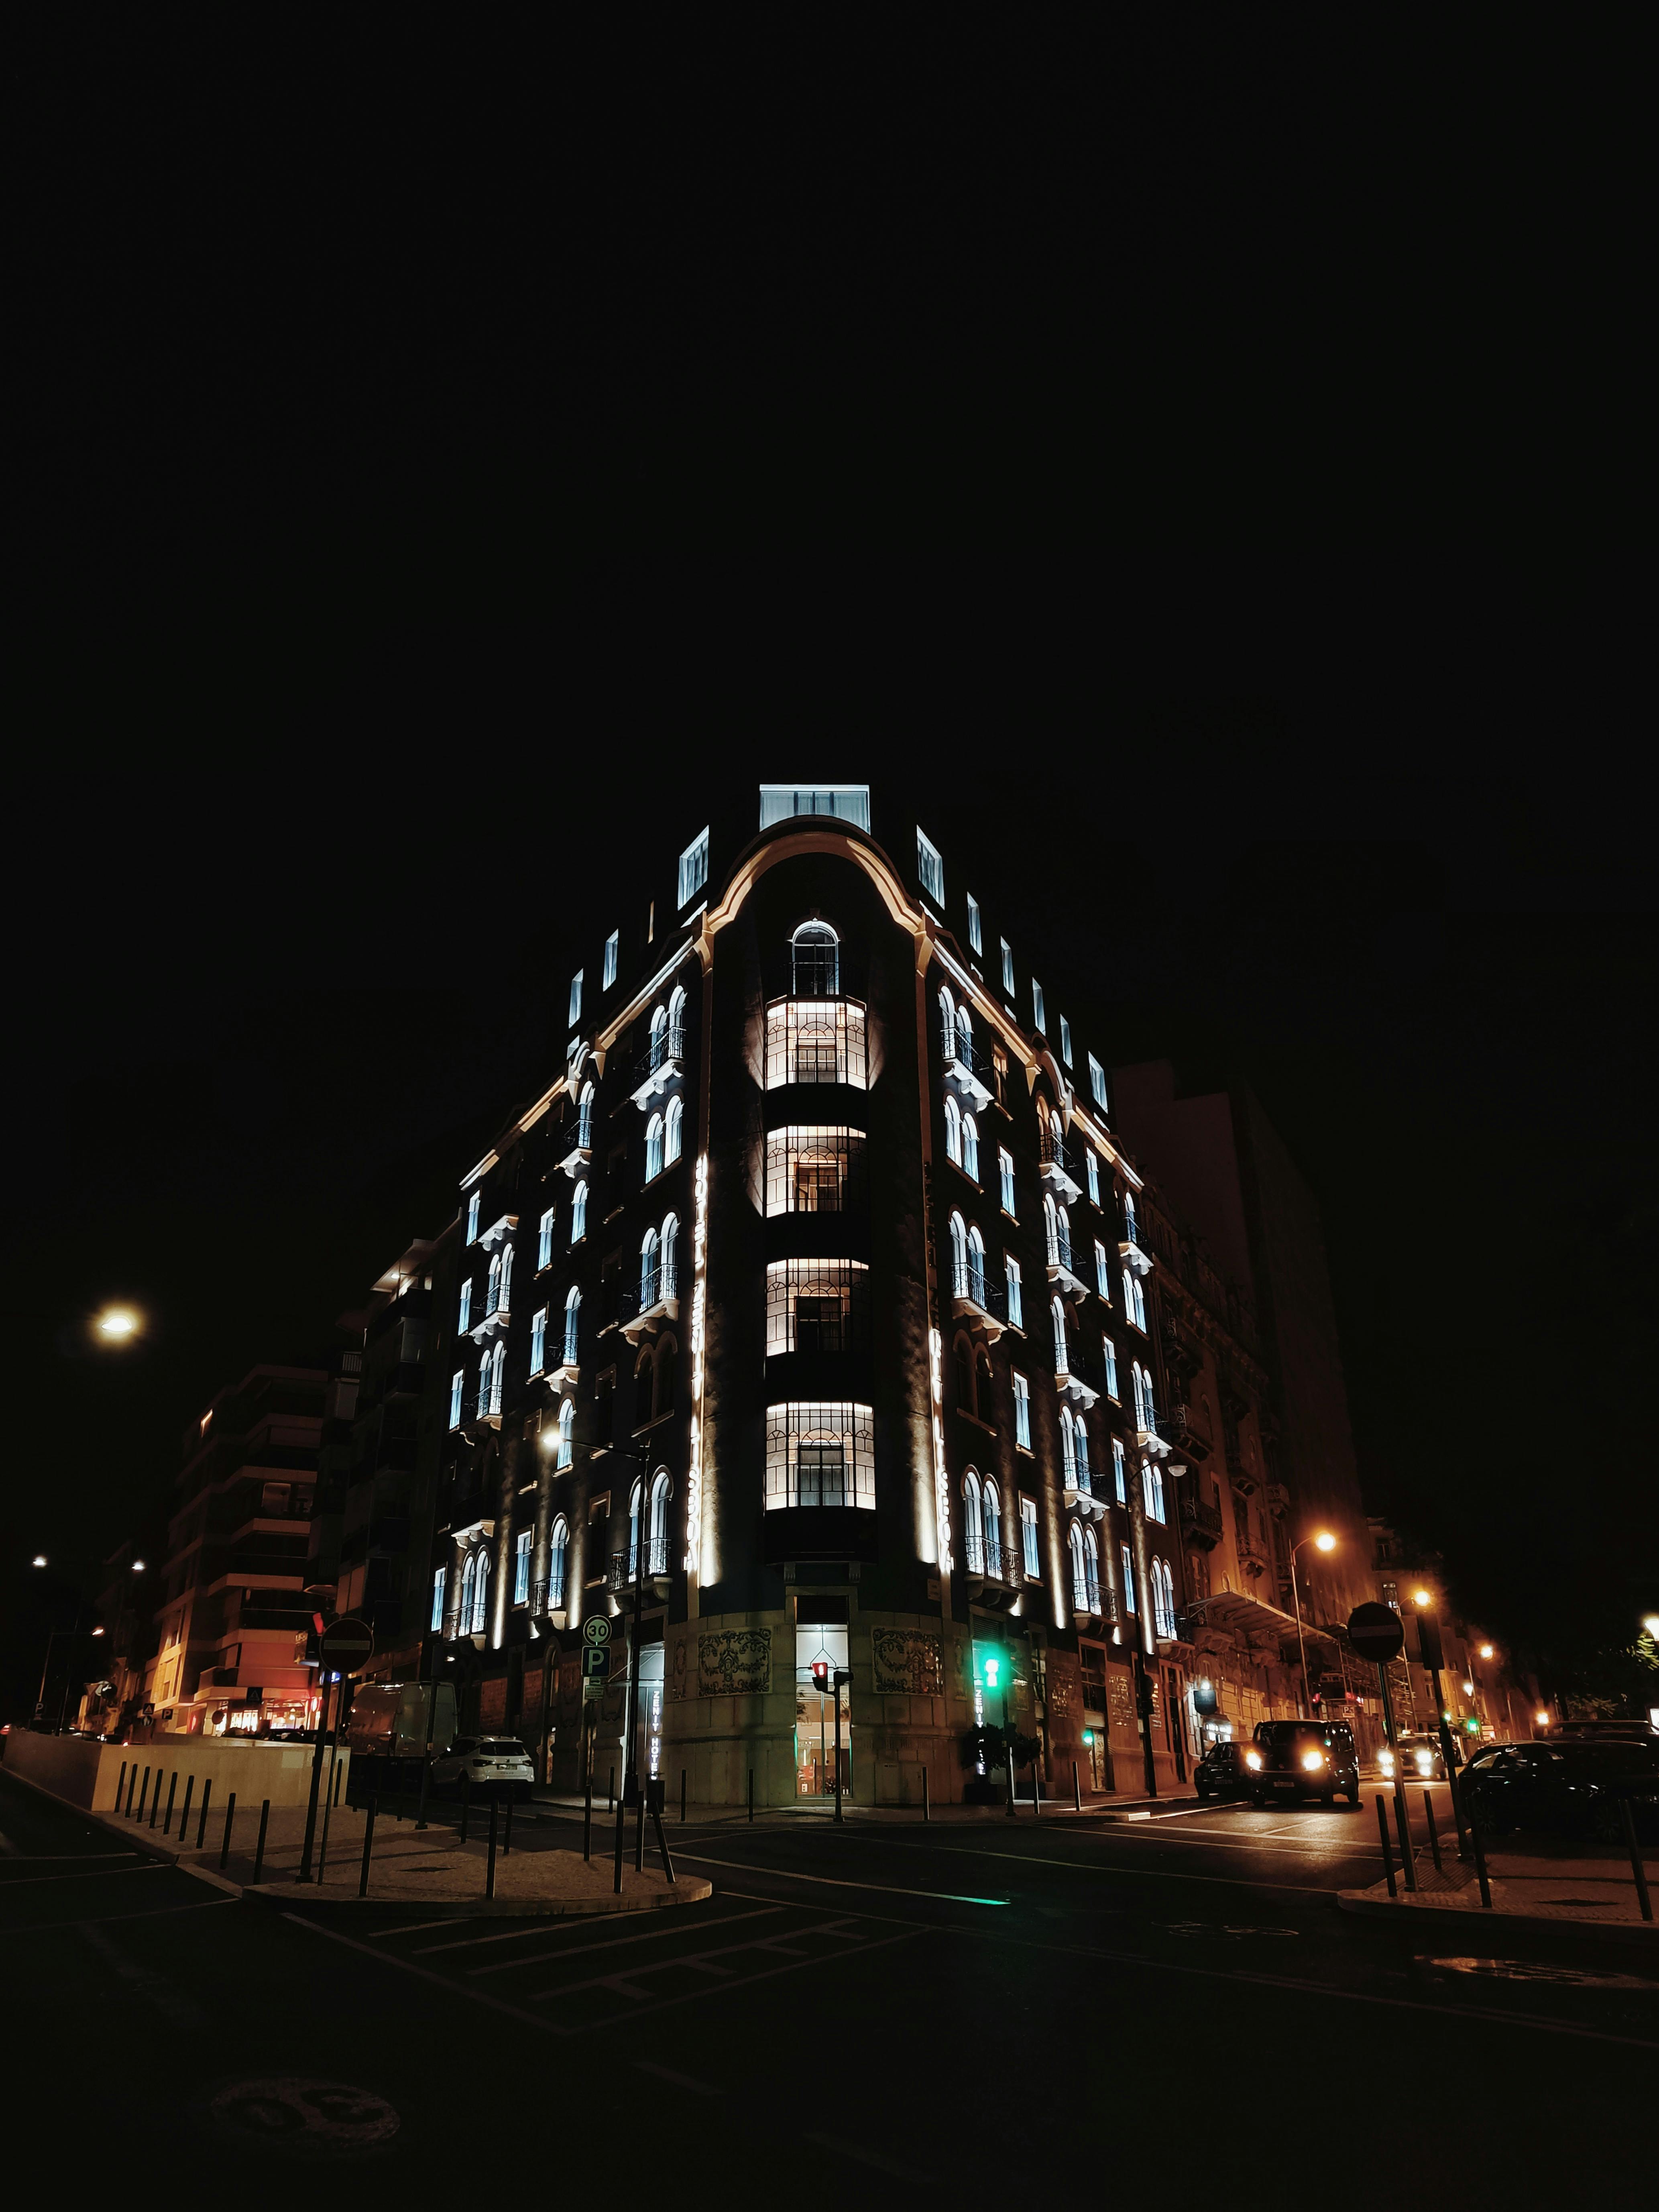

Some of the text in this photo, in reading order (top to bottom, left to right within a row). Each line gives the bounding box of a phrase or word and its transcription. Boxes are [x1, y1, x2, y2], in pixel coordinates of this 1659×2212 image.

[686, 1416, 700, 1572] LISBOA
[934, 1415, 951, 1573] LISBOA
[588, 1625, 607, 1637] 30
[588, 1649, 604, 1674] P
[163, 1709, 171, 1719] P
[652, 1690, 660, 1732] ZENIT
[975, 1689, 984, 1728] ZENIT
